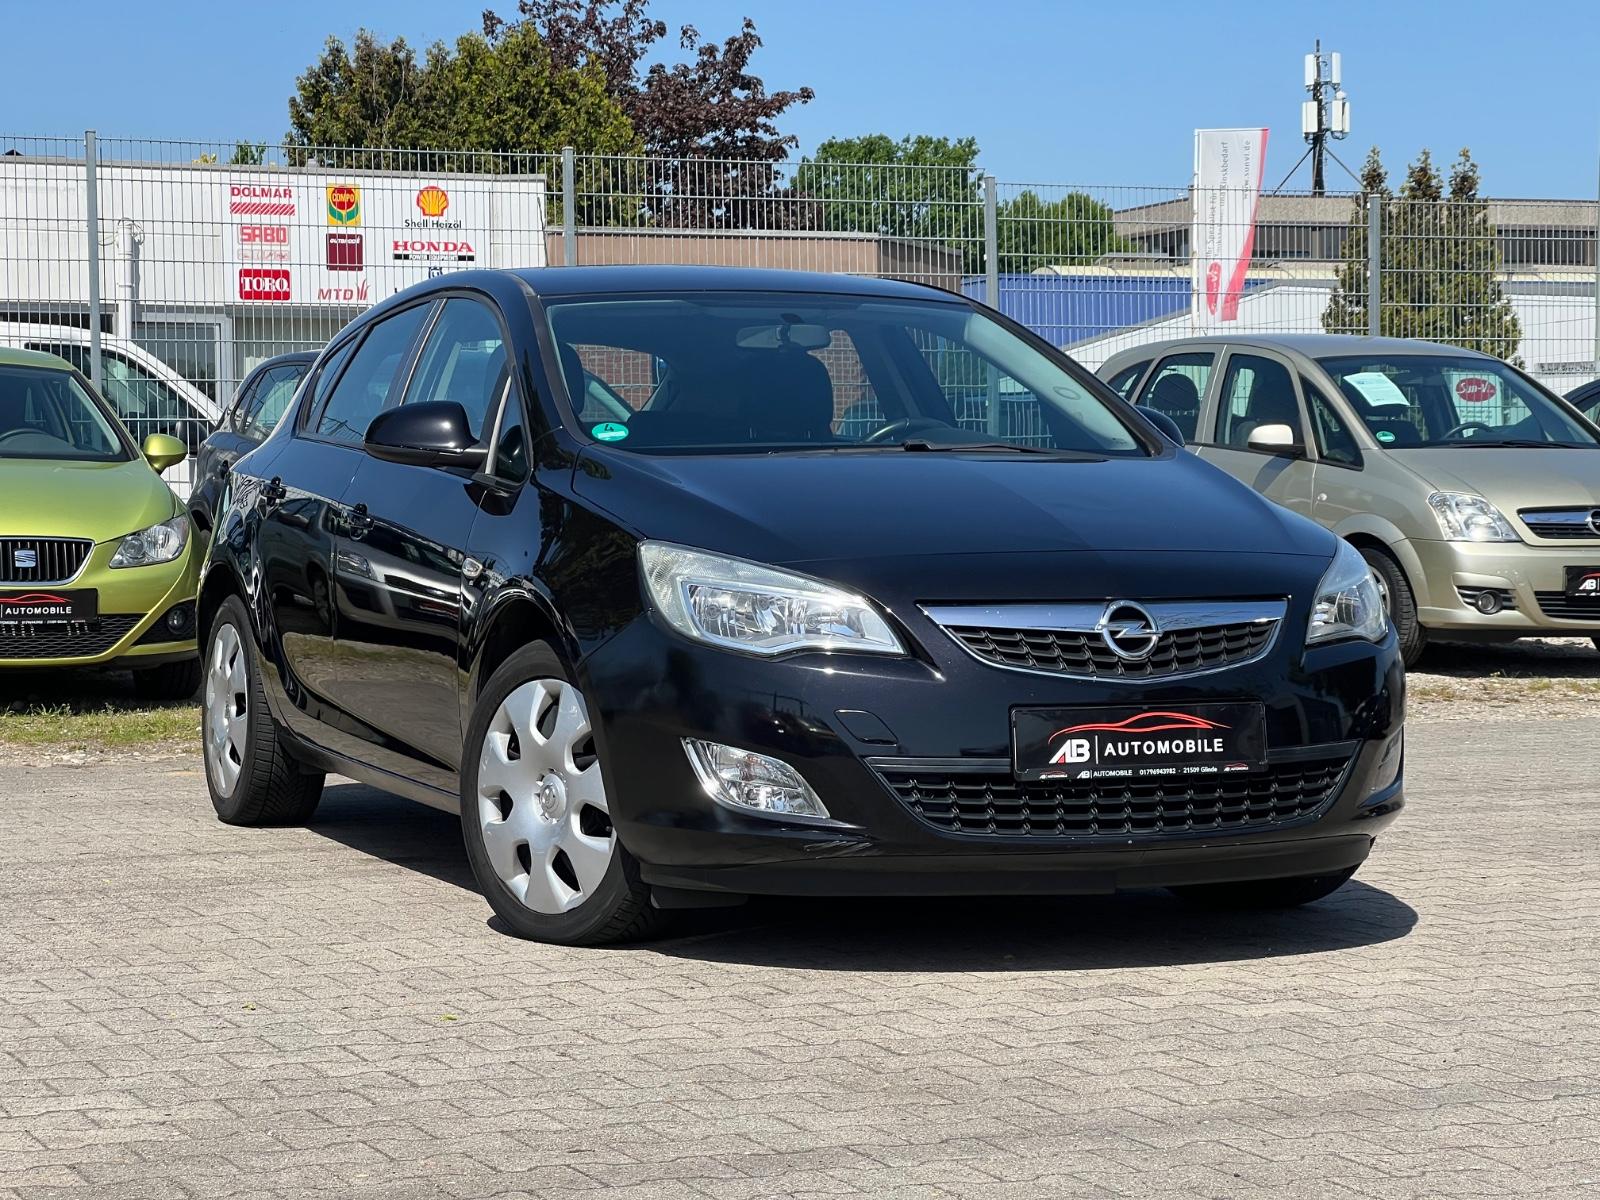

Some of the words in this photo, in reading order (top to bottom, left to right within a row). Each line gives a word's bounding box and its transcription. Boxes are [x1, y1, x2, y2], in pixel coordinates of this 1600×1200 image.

[230, 187, 292, 199] DOLMAR
[332, 193, 355, 203] COMPO
[404, 219, 428, 228] Shell
[431, 219, 462, 229] Heizöl
[240, 226, 287, 243] SABO
[393, 240, 474, 252] HONDA
[318, 288, 354, 301] MTD
[5, 606, 72, 615] AUTOMOBILE
[1049, 739, 1091, 764] AB
[1104, 738, 1224, 757] AUTOMOBILE
[1093, 769, 1133, 778] AUTOMOBILE
[1201, 765, 1218, 773] Glinde
